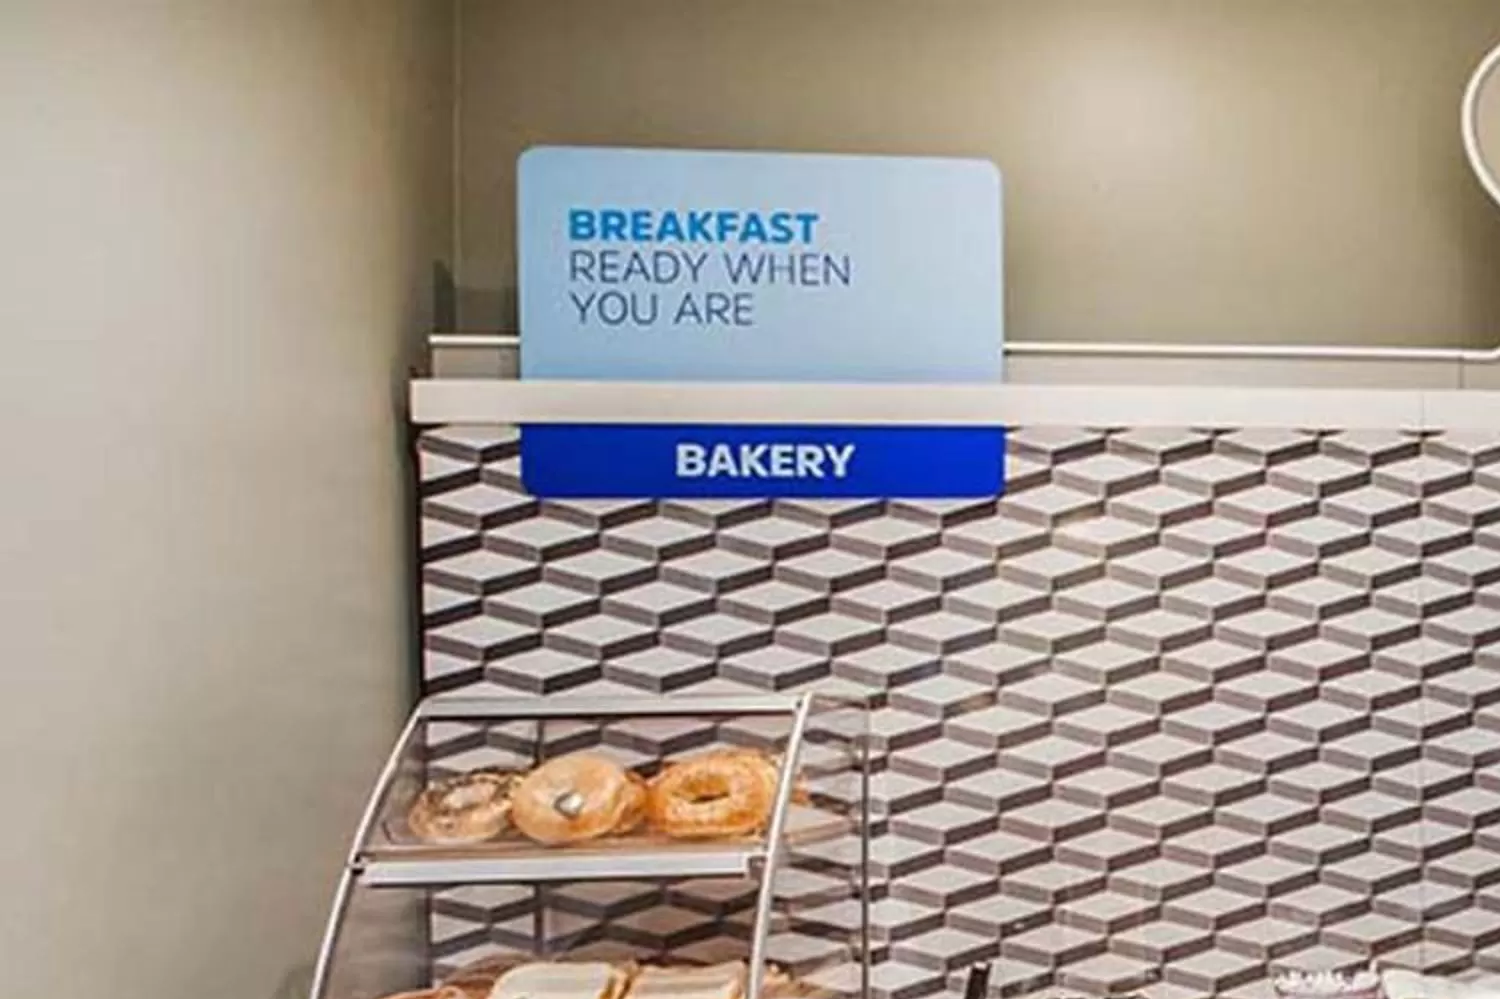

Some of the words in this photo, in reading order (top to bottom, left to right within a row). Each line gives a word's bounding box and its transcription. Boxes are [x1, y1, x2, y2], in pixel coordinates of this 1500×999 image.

[569, 209, 819, 244] BREAKFAST
[570, 250, 705, 285] READY
[722, 252, 851, 287] WHEN
[569, 291, 658, 326] YOU
[673, 294, 754, 327] ARE
[675, 442, 856, 479] BAKERY
